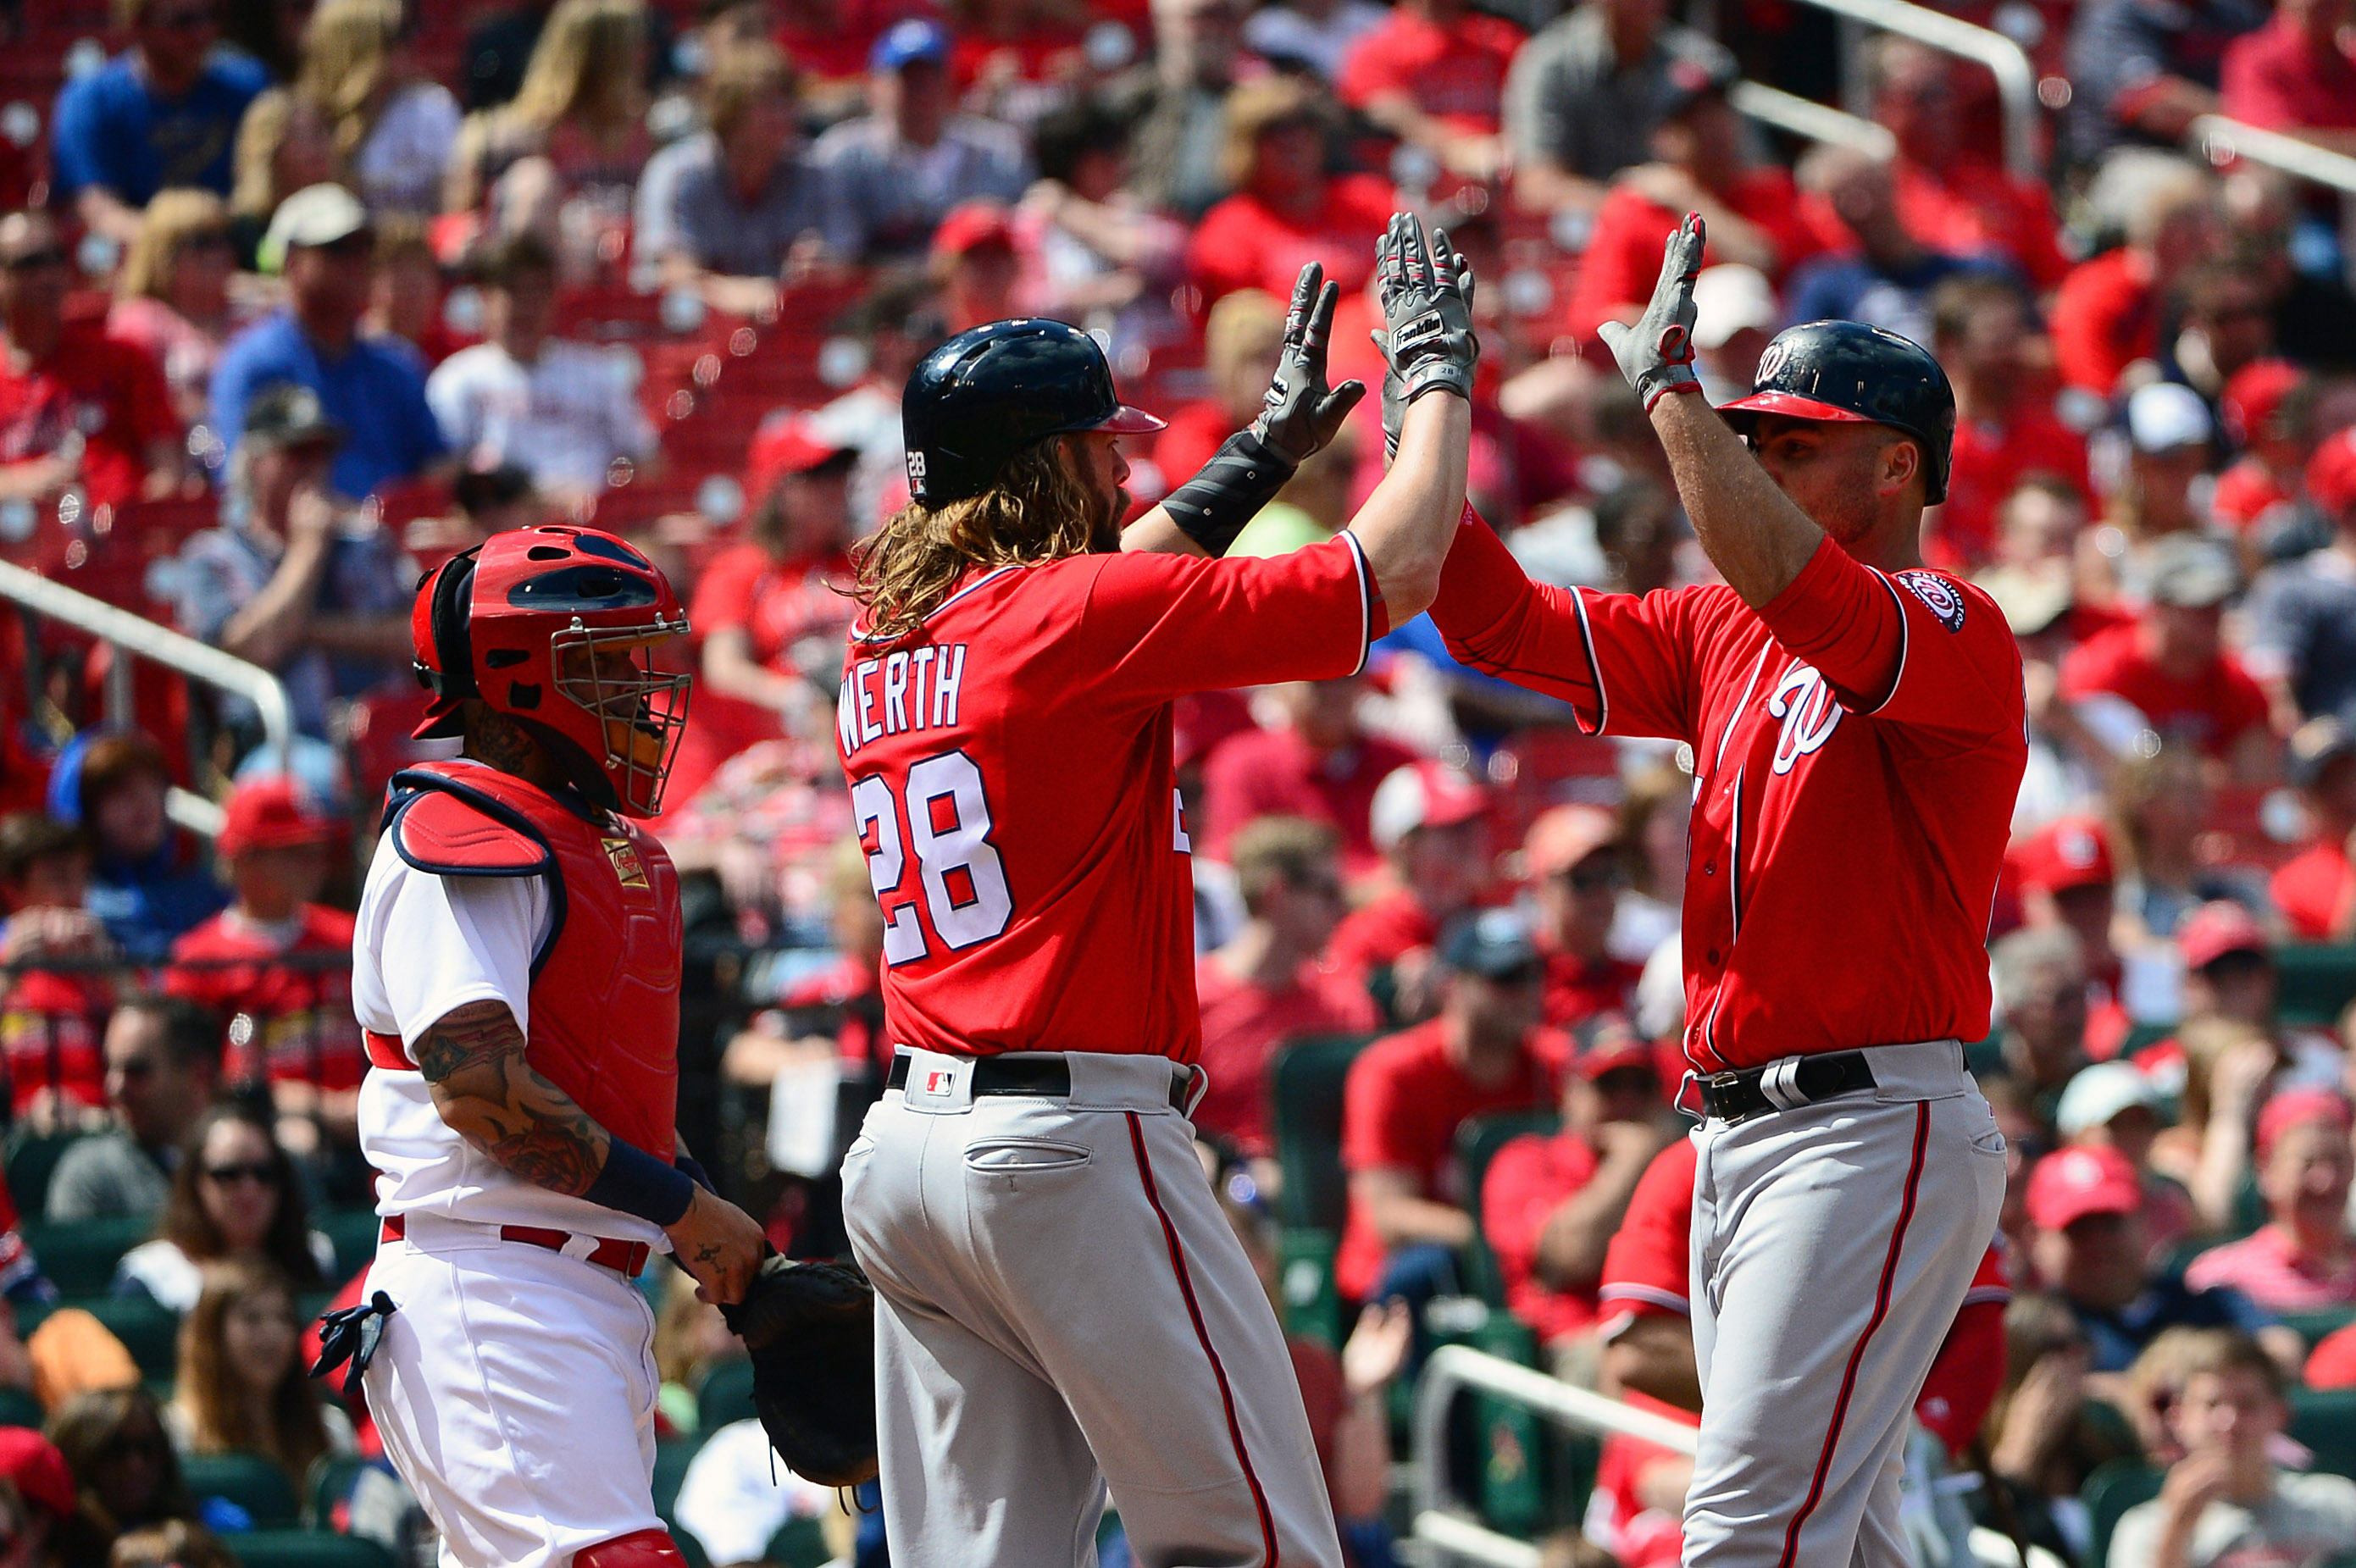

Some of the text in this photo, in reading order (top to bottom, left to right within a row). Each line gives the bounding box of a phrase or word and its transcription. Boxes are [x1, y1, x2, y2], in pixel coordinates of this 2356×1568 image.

[1395, 317, 1440, 350] Franklin
[907, 452, 926, 476] 28
[839, 644, 967, 757] WERTH
[1768, 657, 1843, 774] W
[851, 747, 1015, 967] 28
